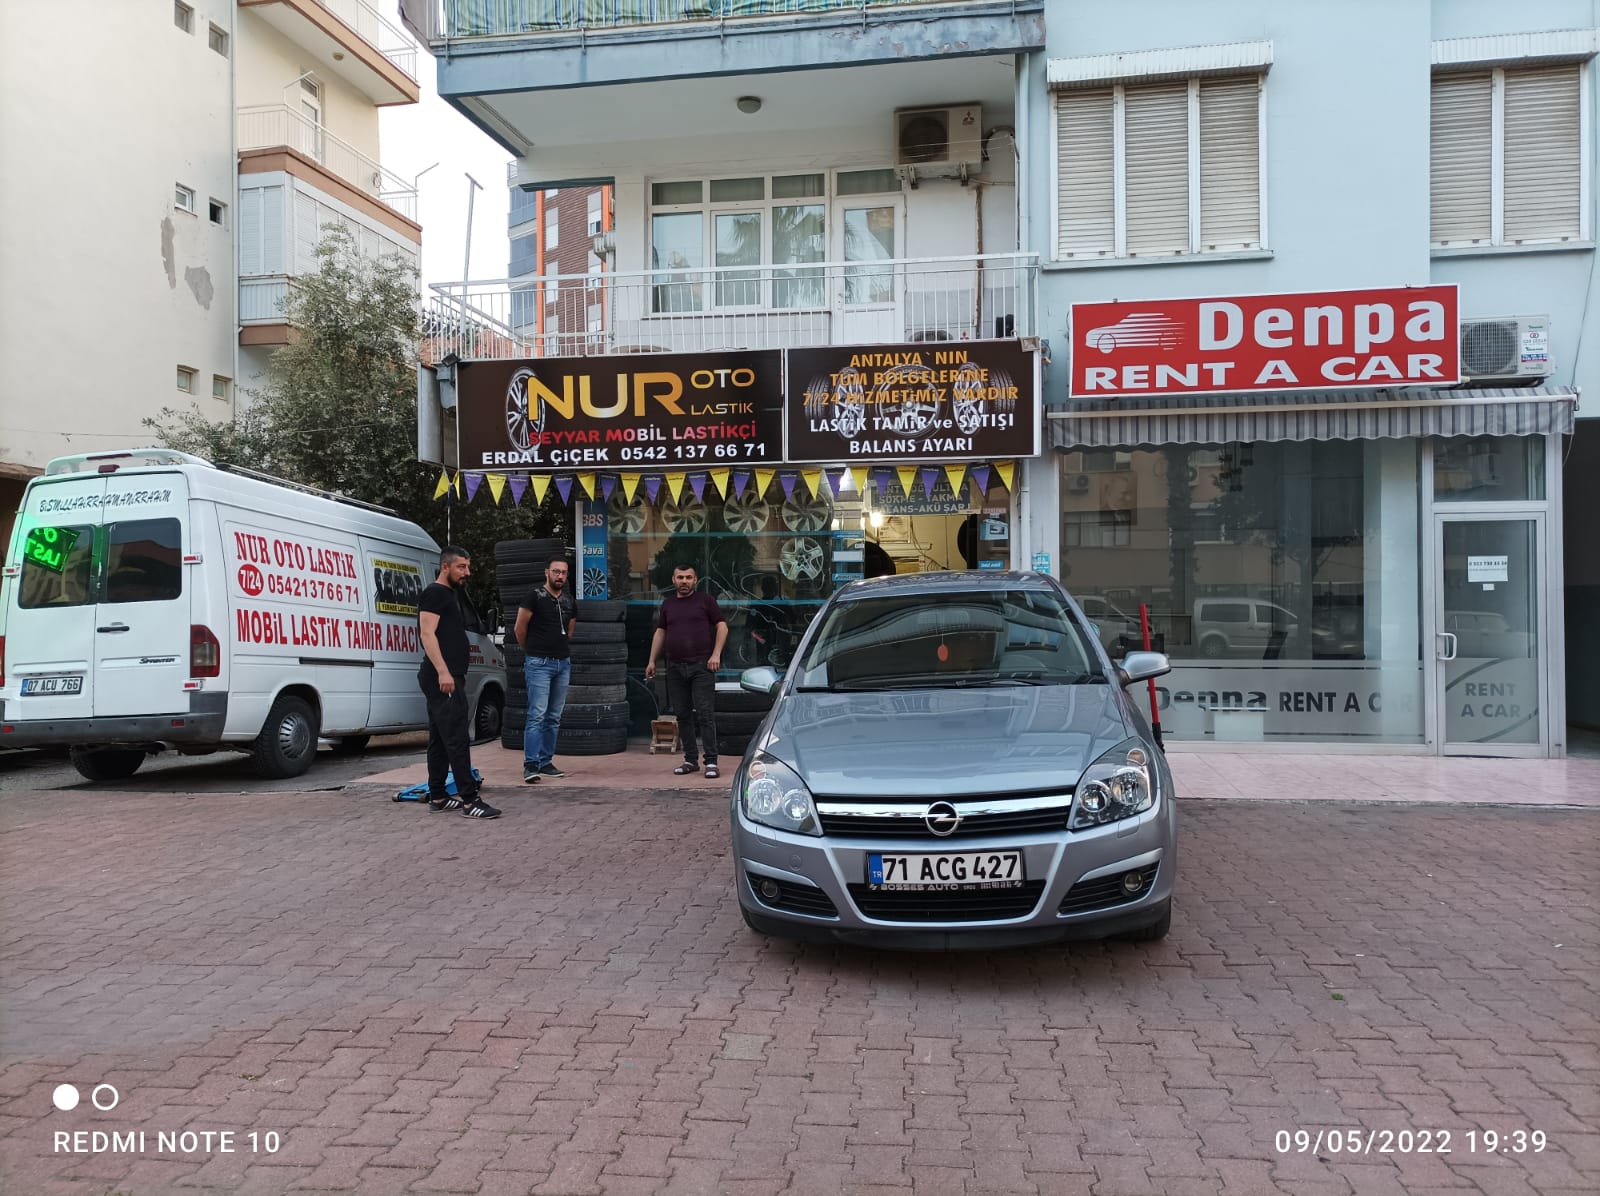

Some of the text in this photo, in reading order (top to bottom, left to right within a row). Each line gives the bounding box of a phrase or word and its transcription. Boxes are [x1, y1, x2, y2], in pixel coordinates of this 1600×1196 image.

[1200, 300, 1445, 353] Denpa
[690, 368, 755, 389] OTO
[1085, 353, 1444, 391] RENT A CAR
[527, 371, 687, 420] NUR
[803, 392, 839, 407] 7/24
[953, 386, 1018, 401] VARDIR
[873, 416, 927, 431] TAMiR
[933, 419, 952, 429] ve
[959, 413, 1014, 431] SATIŞI
[529, 430, 600, 446] SEYYAR
[605, 424, 666, 443] MOBİL
[850, 437, 973, 454] BALANS AYARI
[482, 450, 545, 465] ERDAL
[620, 446, 667, 460] 0542
[673, 445, 708, 459] 137
[714, 443, 738, 457] 66
[743, 442, 766, 457] 71
[234, 531, 271, 566] NUR
[273, 539, 305, 571] OTO
[239, 570, 262, 591] 7/24
[237, 608, 288, 645] MOBiL
[27, 679, 79, 692] 07 ACU 766
[1465, 683, 1517, 697] RENT
[1279, 692, 1336, 712] RENT
[1343, 692, 1361, 712] A
[1461, 703, 1521, 718] A CAR
[882, 854, 1018, 881] 71 ACG 427
[927, 883, 959, 891] AUTO
